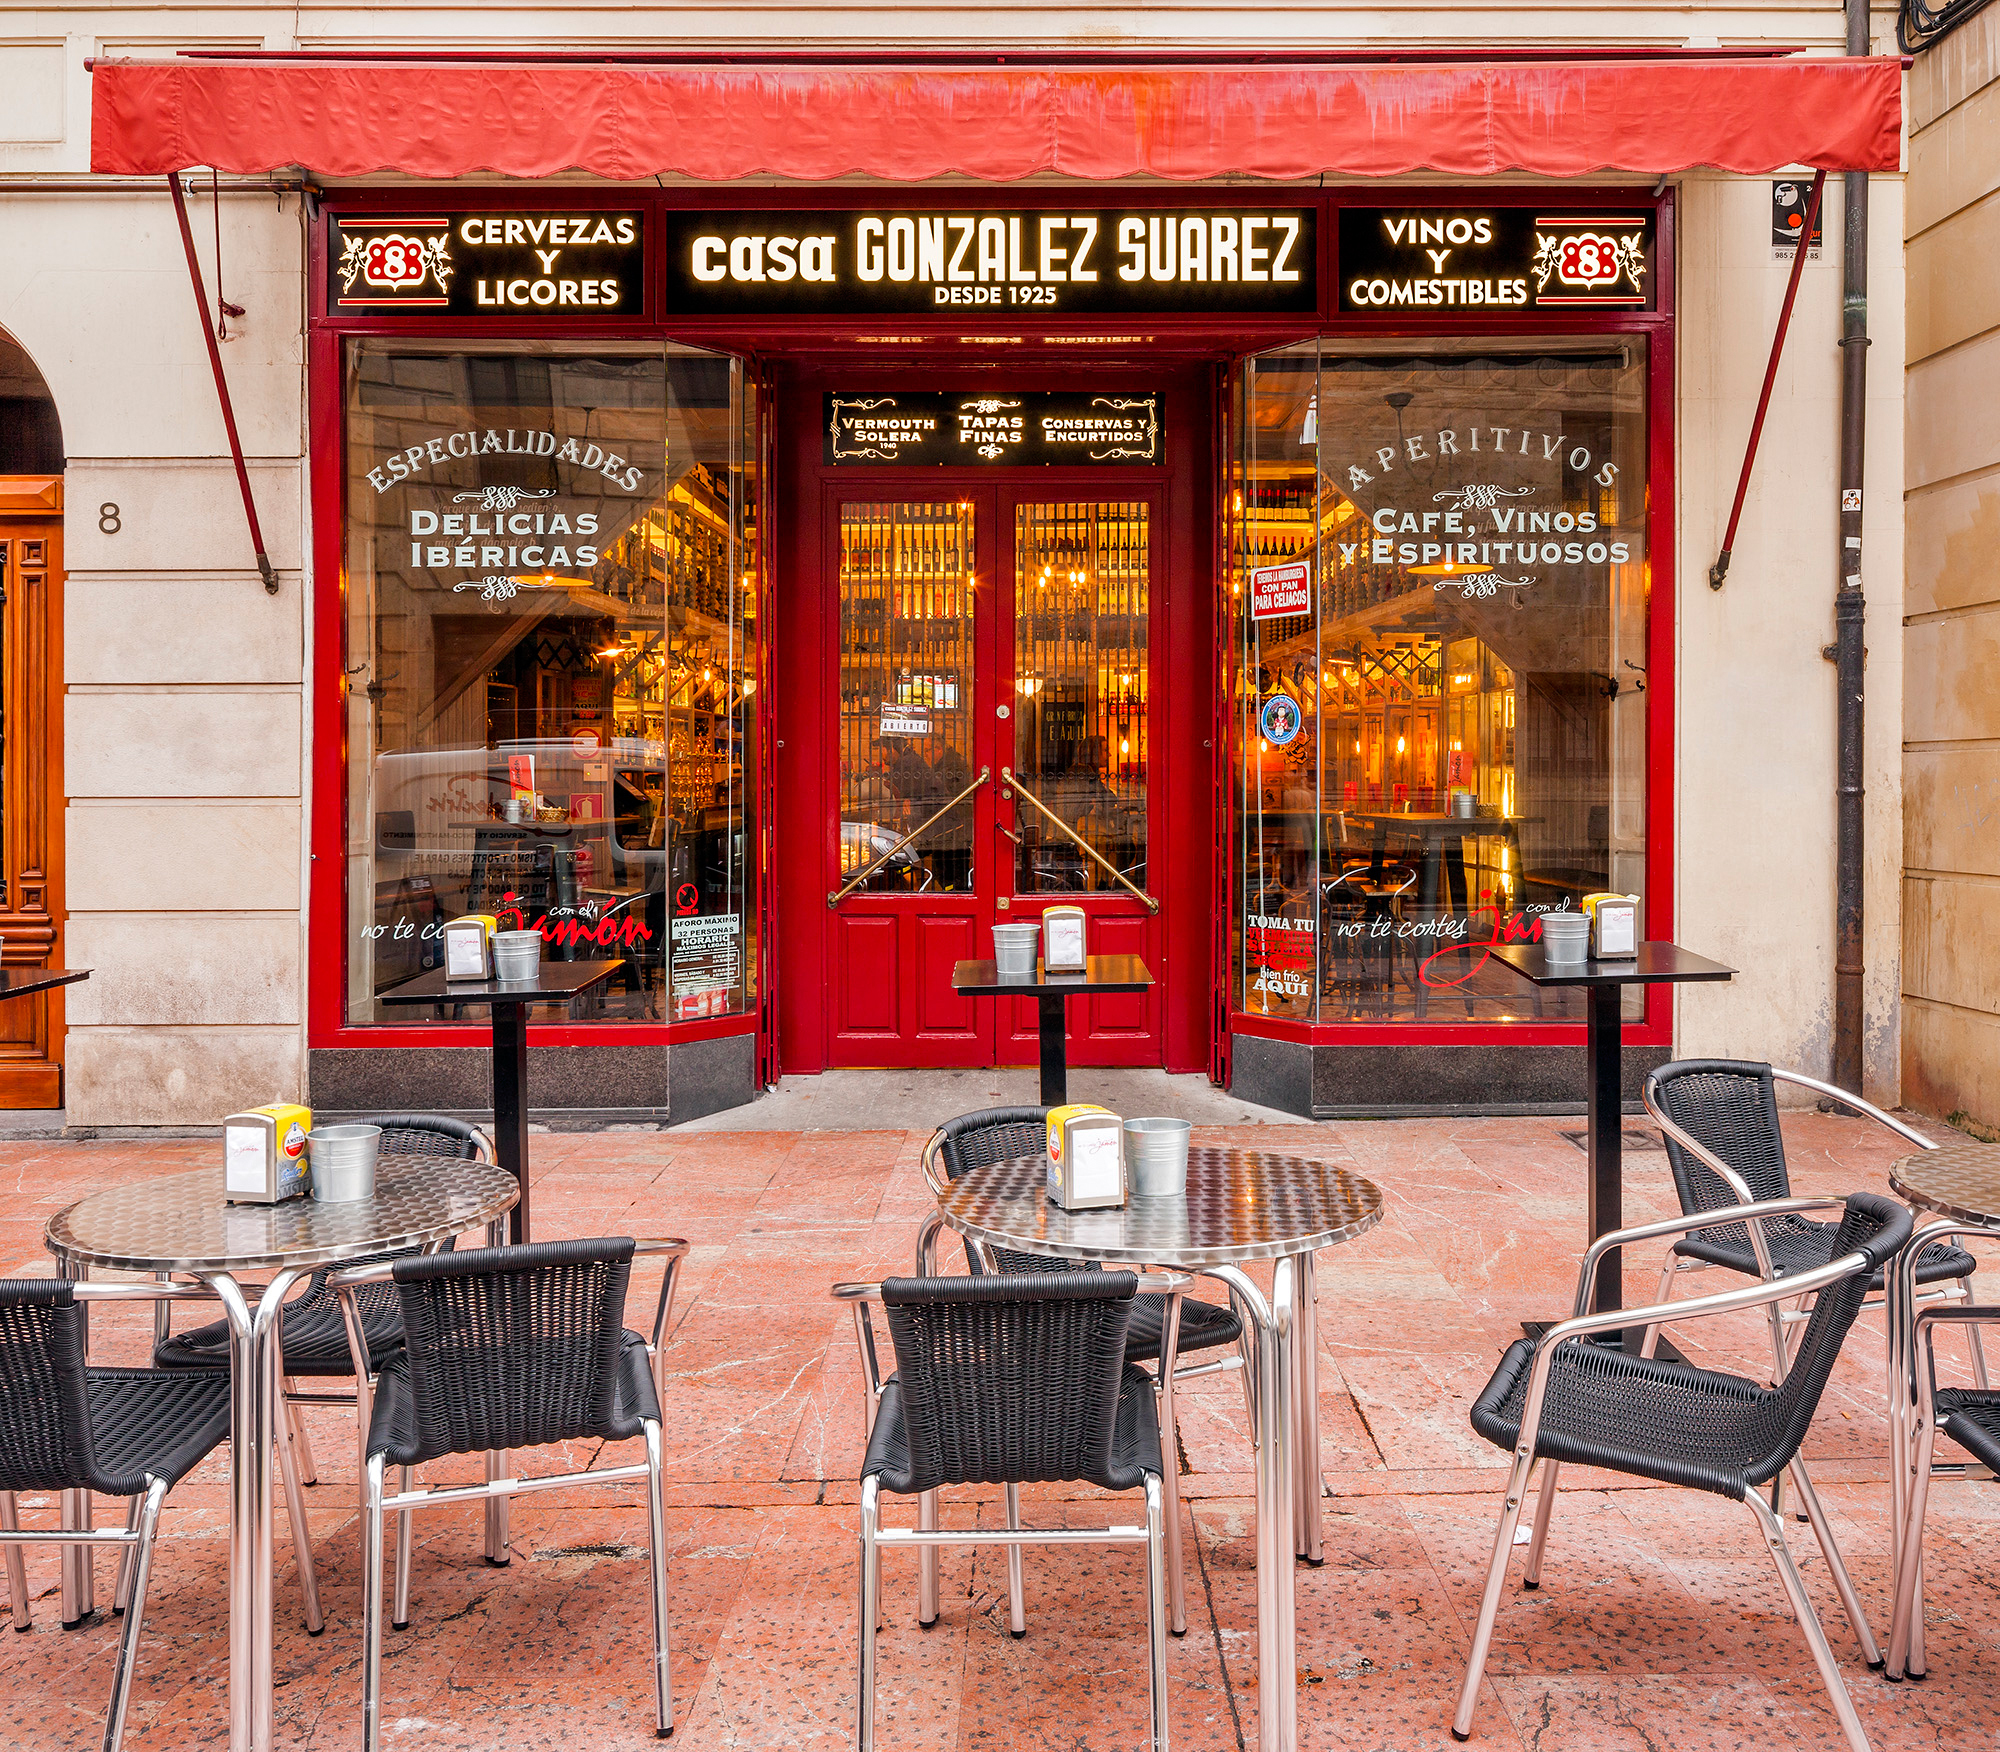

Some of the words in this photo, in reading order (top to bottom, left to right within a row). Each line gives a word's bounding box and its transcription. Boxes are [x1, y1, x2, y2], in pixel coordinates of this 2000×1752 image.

[461, 219, 635, 245] CERVEZAS
[1383, 218, 1492, 245] VINOS
[691, 236, 836, 283] casa
[857, 216, 1098, 283] GONZALEZ
[1119, 216, 1300, 283] SUAREZ
[535, 249, 561, 274] Y
[1426, 249, 1452, 274] Y
[478, 279, 619, 305] LICORES
[934, 286, 1001, 304] DESDE
[1009, 286, 1057, 305] 1925
[1350, 279, 1528, 305] COMESTIBLES
[842, 418, 935, 430] VERMOUTH
[959, 415, 1024, 429] TAPAS
[1042, 418, 1132, 429] CONSERVAS
[1133, 419, 1146, 430] Y
[854, 430, 922, 442] SOLERA
[960, 430, 1023, 443] FINAS
[1045, 431, 1144, 442] ENCURTIDOS
[365, 429, 644, 494] ESPECIALIDADES
[1349, 427, 1620, 492] APERITIVOS
[99, 502, 121, 534] 8
[410, 509, 599, 536] DELICIAS
[1491, 508, 1597, 533] VINOS
[411, 536, 599, 568] IBÉRICAS
[1372, 538, 1630, 564] ESPIRITUOSOS
[1262, 582, 1279, 593] CON
[1281, 580, 1298, 591] PAN
[1255, 593, 1273, 610] PARA
[1274, 589, 1306, 608] CELIACOS
[884, 722, 926, 731] ABIERTO
[550, 906, 574, 918] con
[1525, 903, 1550, 913] con
[1554, 896, 1570, 914] el
[360, 923, 389, 939] no
[393, 915, 414, 939] te
[674, 919, 702, 927] AFORO
[690, 926, 734, 936] PERSONAS
[1248, 915, 1291, 930] TOMA
[1294, 918, 1314, 932] TU
[1337, 919, 1361, 938] no
[1370, 914, 1393, 938] te
[1396, 914, 1468, 939] cortes
[681, 934, 729, 946] HORARIO
[1248, 927, 1314, 944] VERMOUTH
[1248, 939, 1314, 957] SOLERA
[1260, 966, 1281, 979] bien
[1283, 969, 1300, 982] frío
[1253, 978, 1309, 996] AQUÍ
